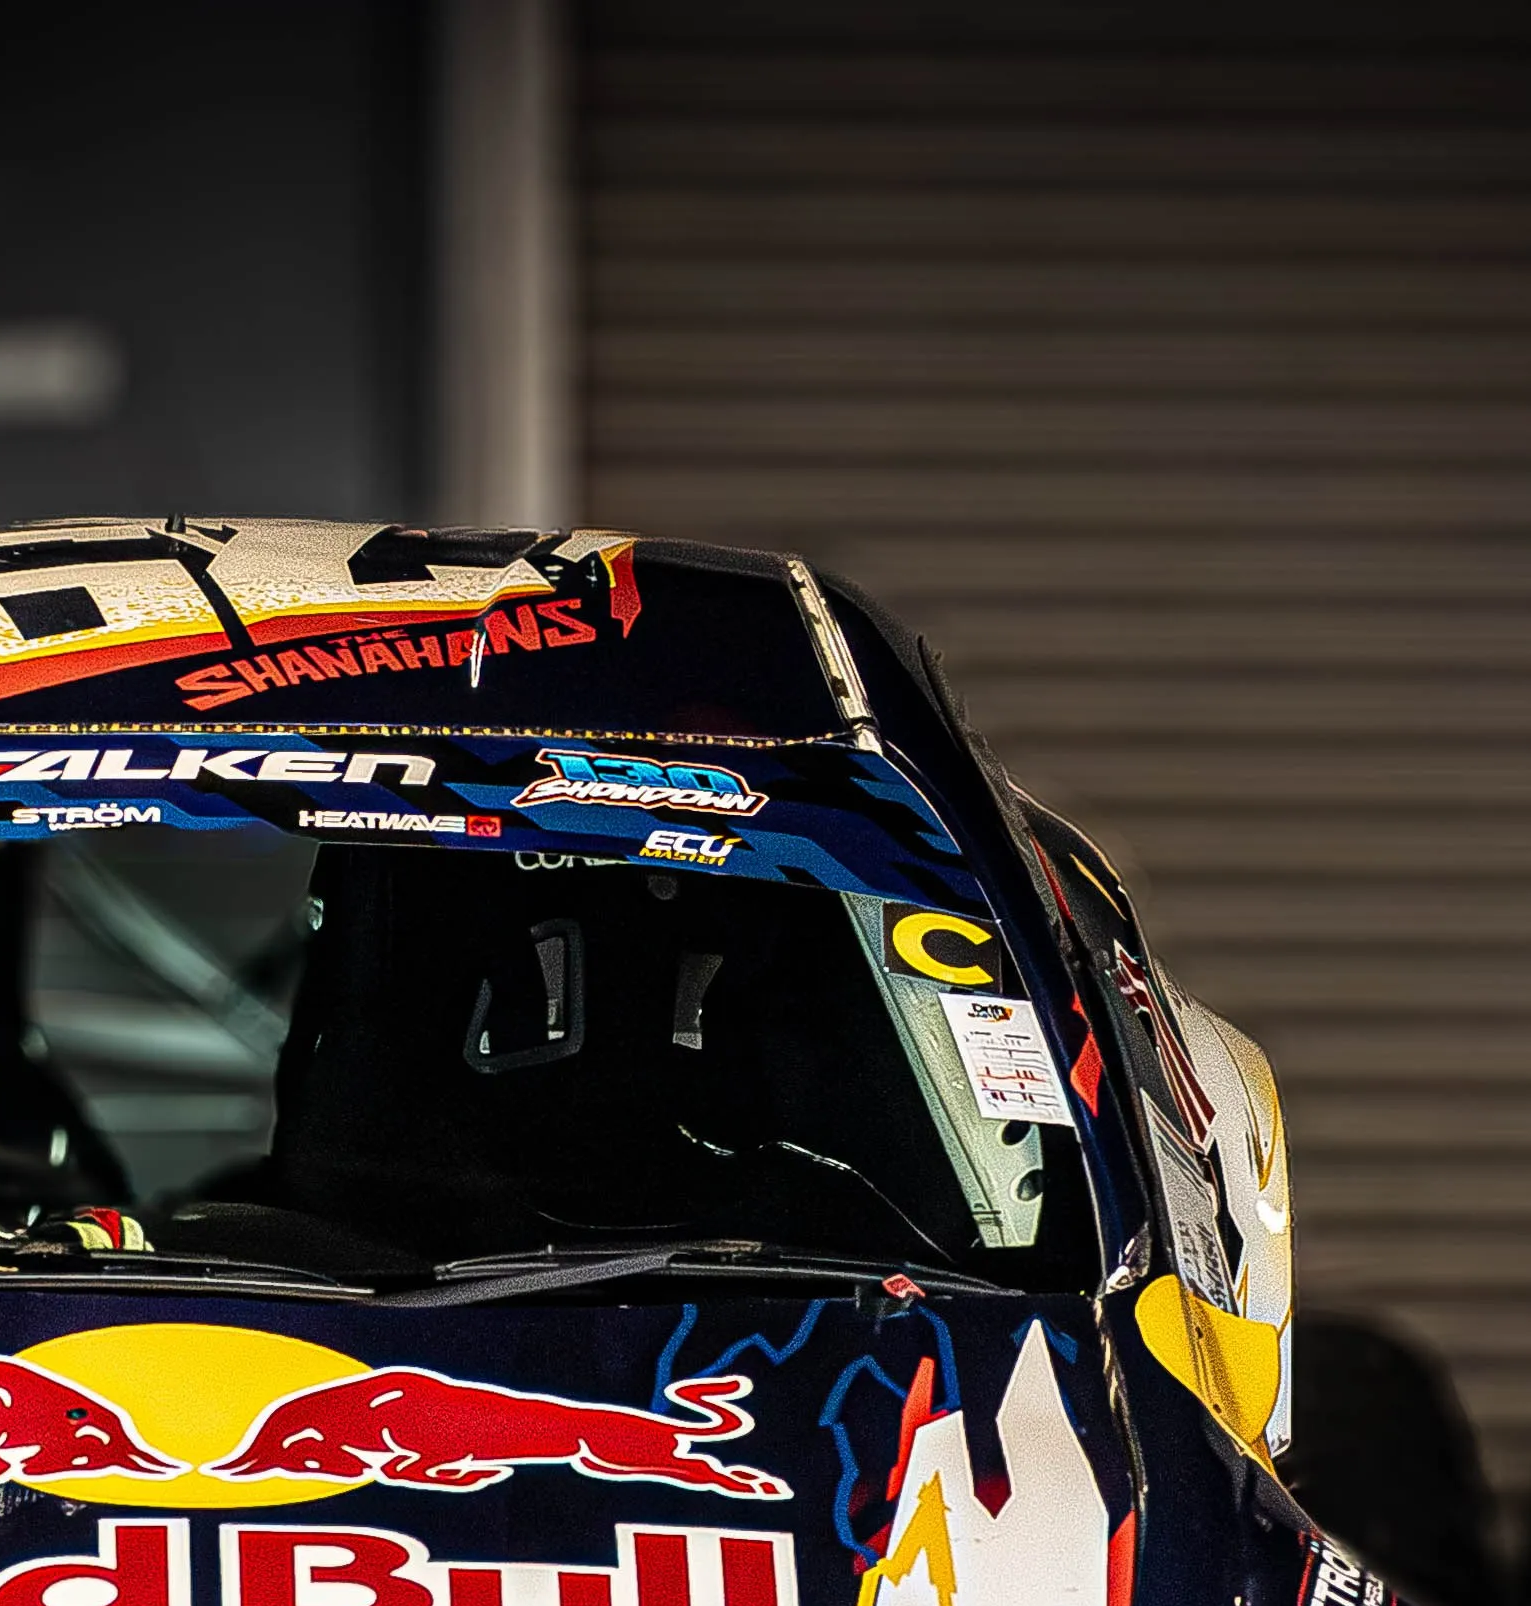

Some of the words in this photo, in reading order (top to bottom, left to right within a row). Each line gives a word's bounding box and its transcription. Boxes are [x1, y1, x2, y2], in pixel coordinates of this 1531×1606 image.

[174, 599, 597, 711] SHANAHANS
[548, 754, 739, 795] 130
[533, 780, 760, 811] SHOWDOWN
[11, 803, 162, 825] STRÖM
[298, 810, 466, 833] HEATWAVE
[645, 829, 742, 857] ECU
[892, 912, 994, 987] C
